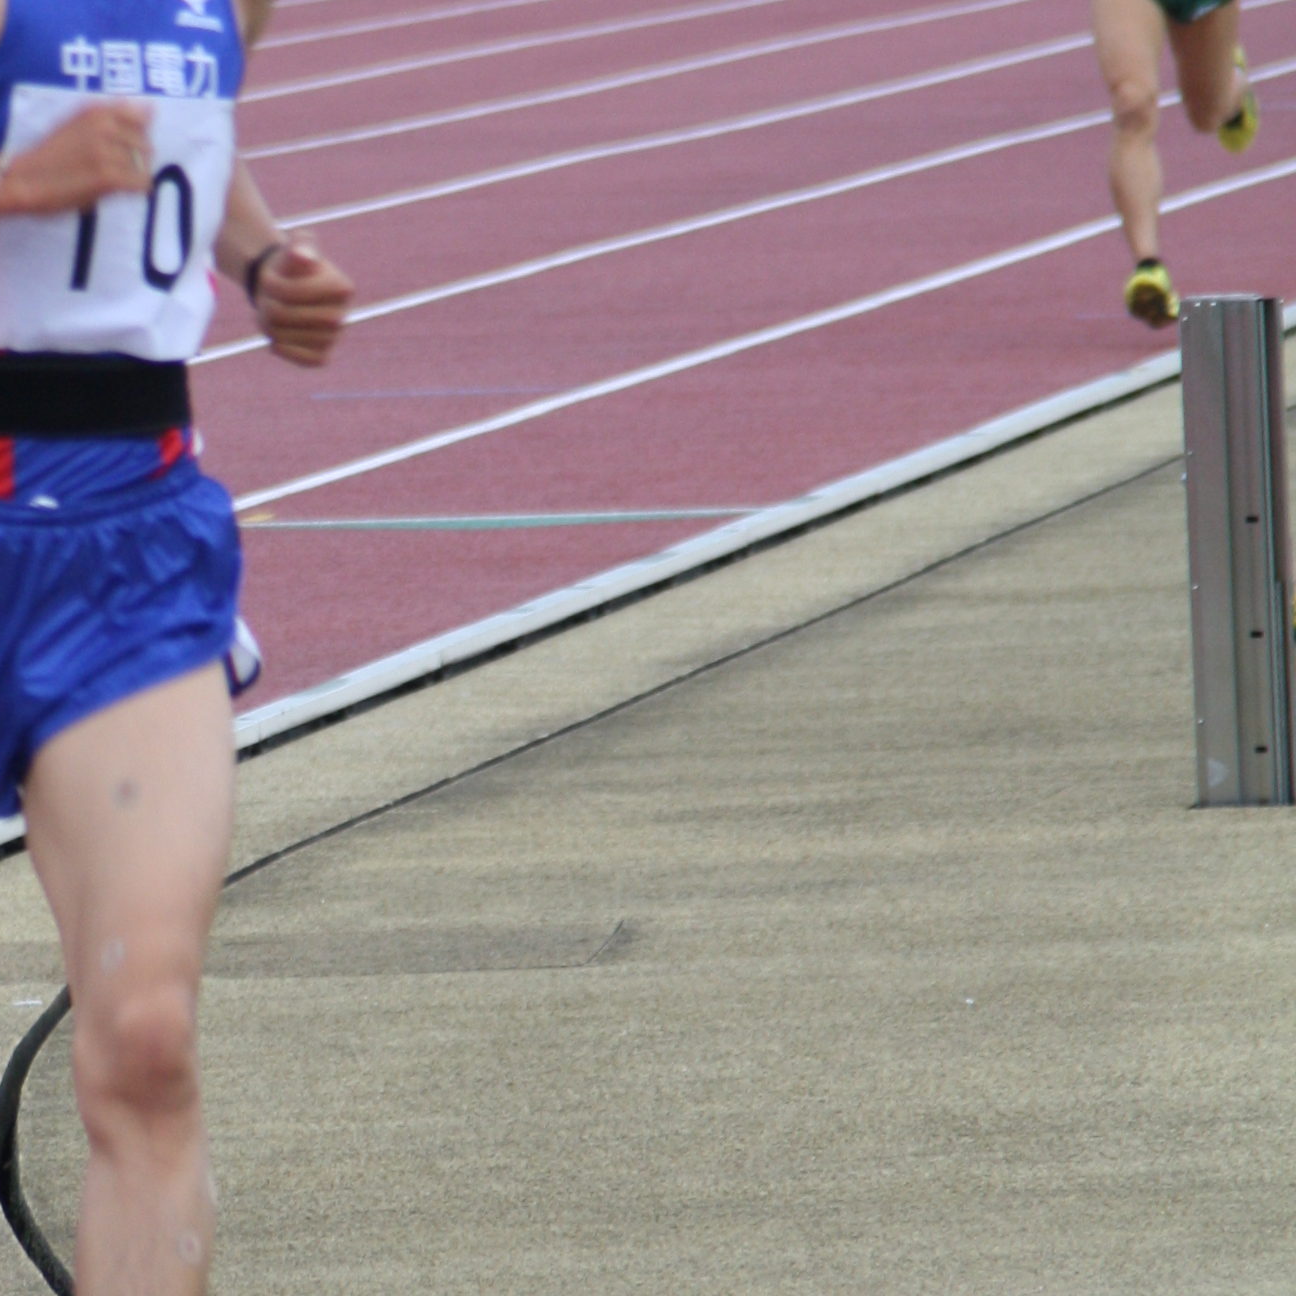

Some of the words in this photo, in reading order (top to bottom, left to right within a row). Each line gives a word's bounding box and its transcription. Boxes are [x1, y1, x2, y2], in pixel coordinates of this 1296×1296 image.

[60, 35, 219, 97] 中国電力
[69, 163, 193, 292] 10
